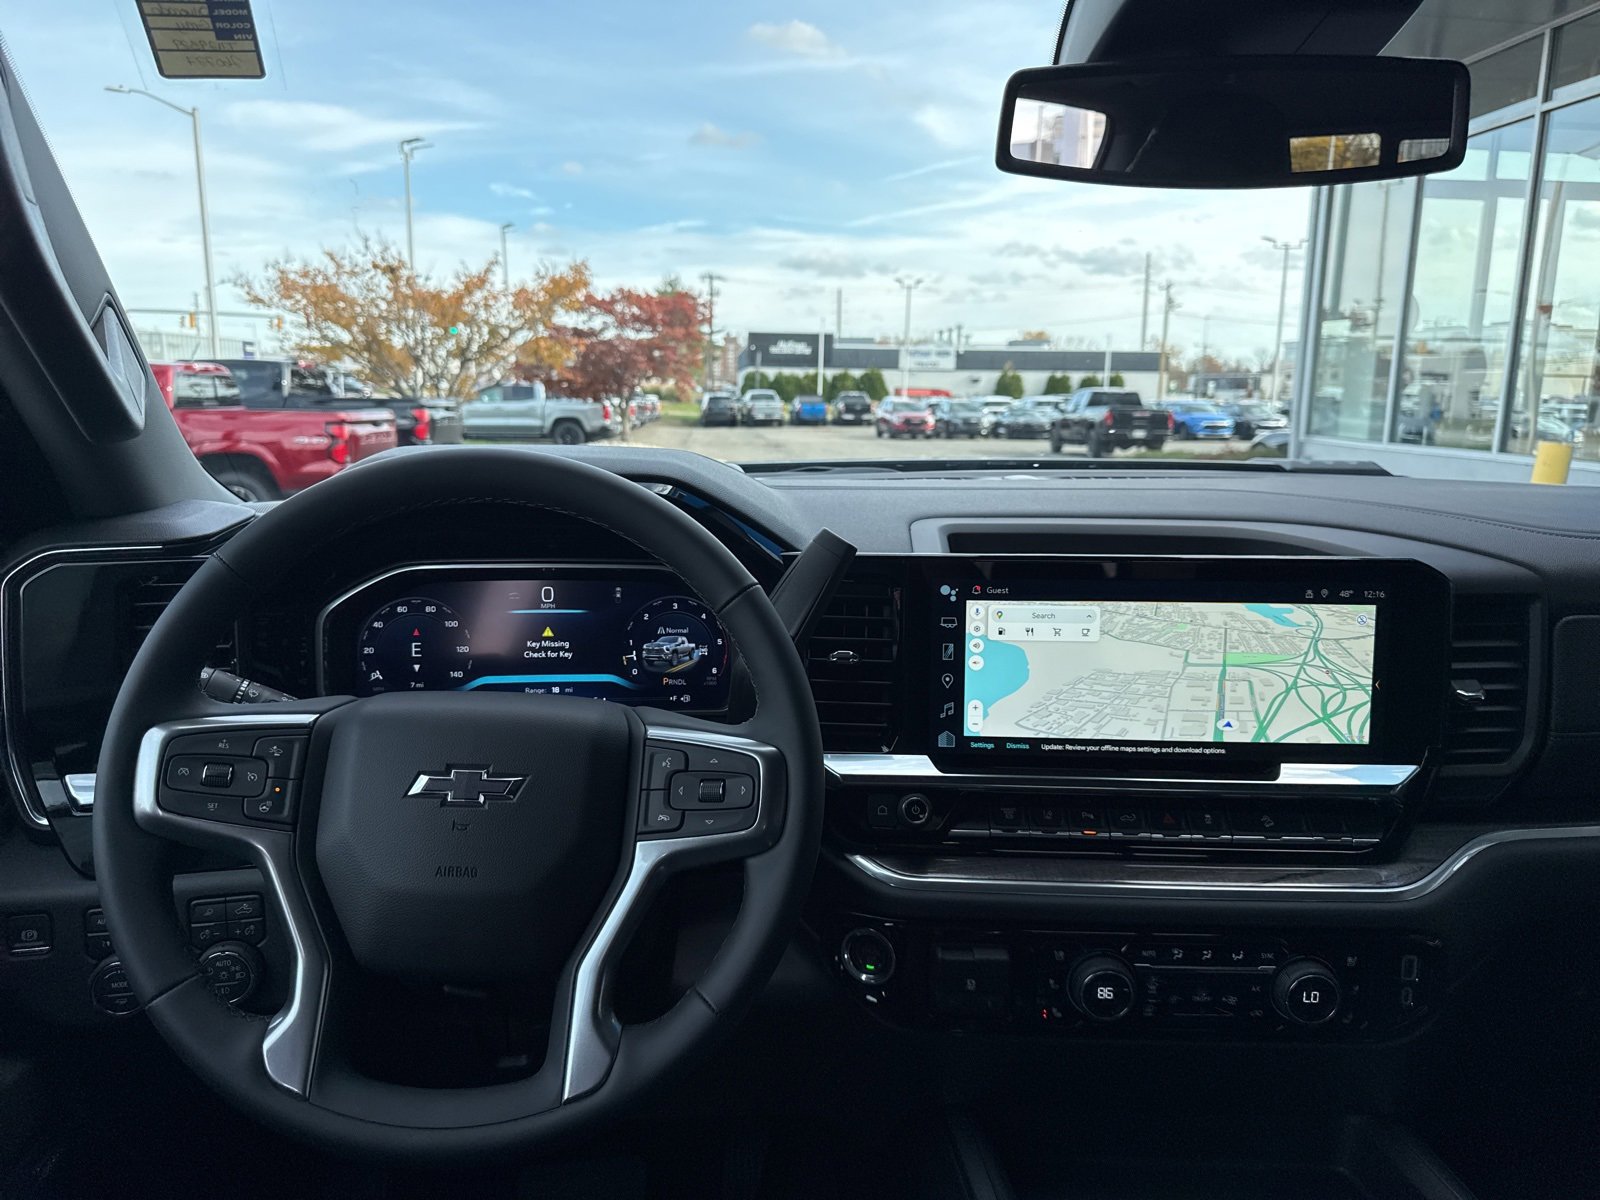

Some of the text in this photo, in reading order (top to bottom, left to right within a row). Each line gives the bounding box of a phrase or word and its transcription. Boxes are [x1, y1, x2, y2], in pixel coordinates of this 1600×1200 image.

[541, 586, 555, 602] 0
[986, 586, 1009, 595] Guest
[1364, 590, 1385, 598] 12:16
[397, 605, 408, 613] 60
[425, 605, 436, 613] 80
[1031, 611, 1056, 620] Search
[444, 620, 459, 628] 100
[456, 645, 470, 653] 120
[527, 640, 570, 649] Key Missing
[411, 642, 422, 657] E
[523, 651, 546, 659] Check
[559, 651, 573, 660] Key
[551, 686, 560, 694] 18
[970, 741, 995, 750] Settings
[1006, 742, 1030, 750] Dismiss
[1041, 743, 1065, 752] Update:
[1065, 743, 1086, 751] Review
[1086, 745, 1100, 753] your
[1100, 744, 1119, 752] offline
[1136, 746, 1161, 755] settings
[435, 865, 479, 878] AIRBAG
[216, 959, 231, 967] AUTO
[1097, 986, 1114, 1000] 86
[1302, 991, 1320, 1003] LO
